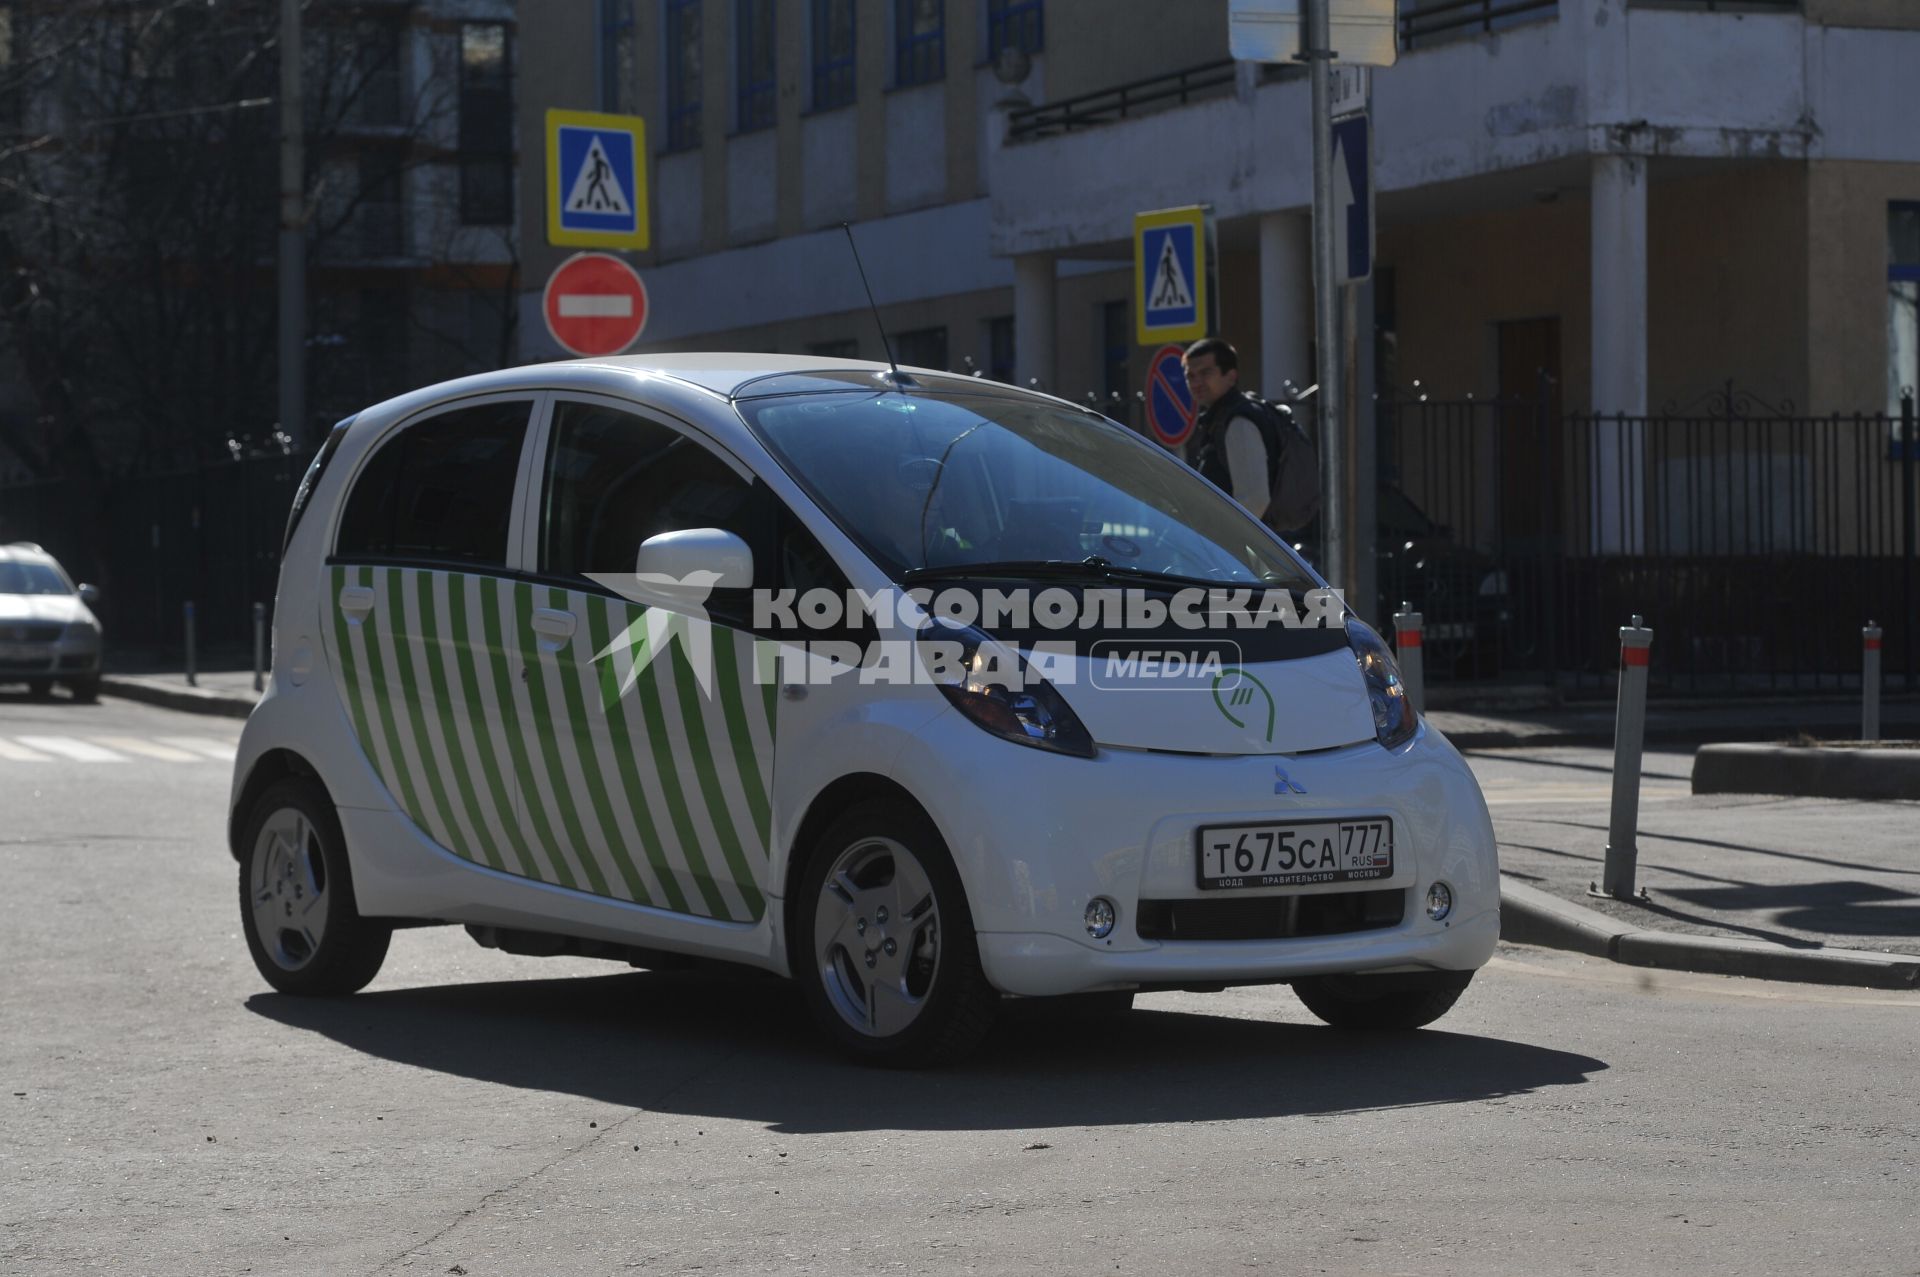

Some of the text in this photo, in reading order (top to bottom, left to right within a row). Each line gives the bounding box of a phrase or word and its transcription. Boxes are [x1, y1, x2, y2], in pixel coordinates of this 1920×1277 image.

[1214, 825, 1383, 874] Т675СА 777
[1351, 855, 1372, 866] RUS
[1219, 869, 1380, 888] ЦОДД ПРАВИТЕЛЬСТВО МОСКВЫ
